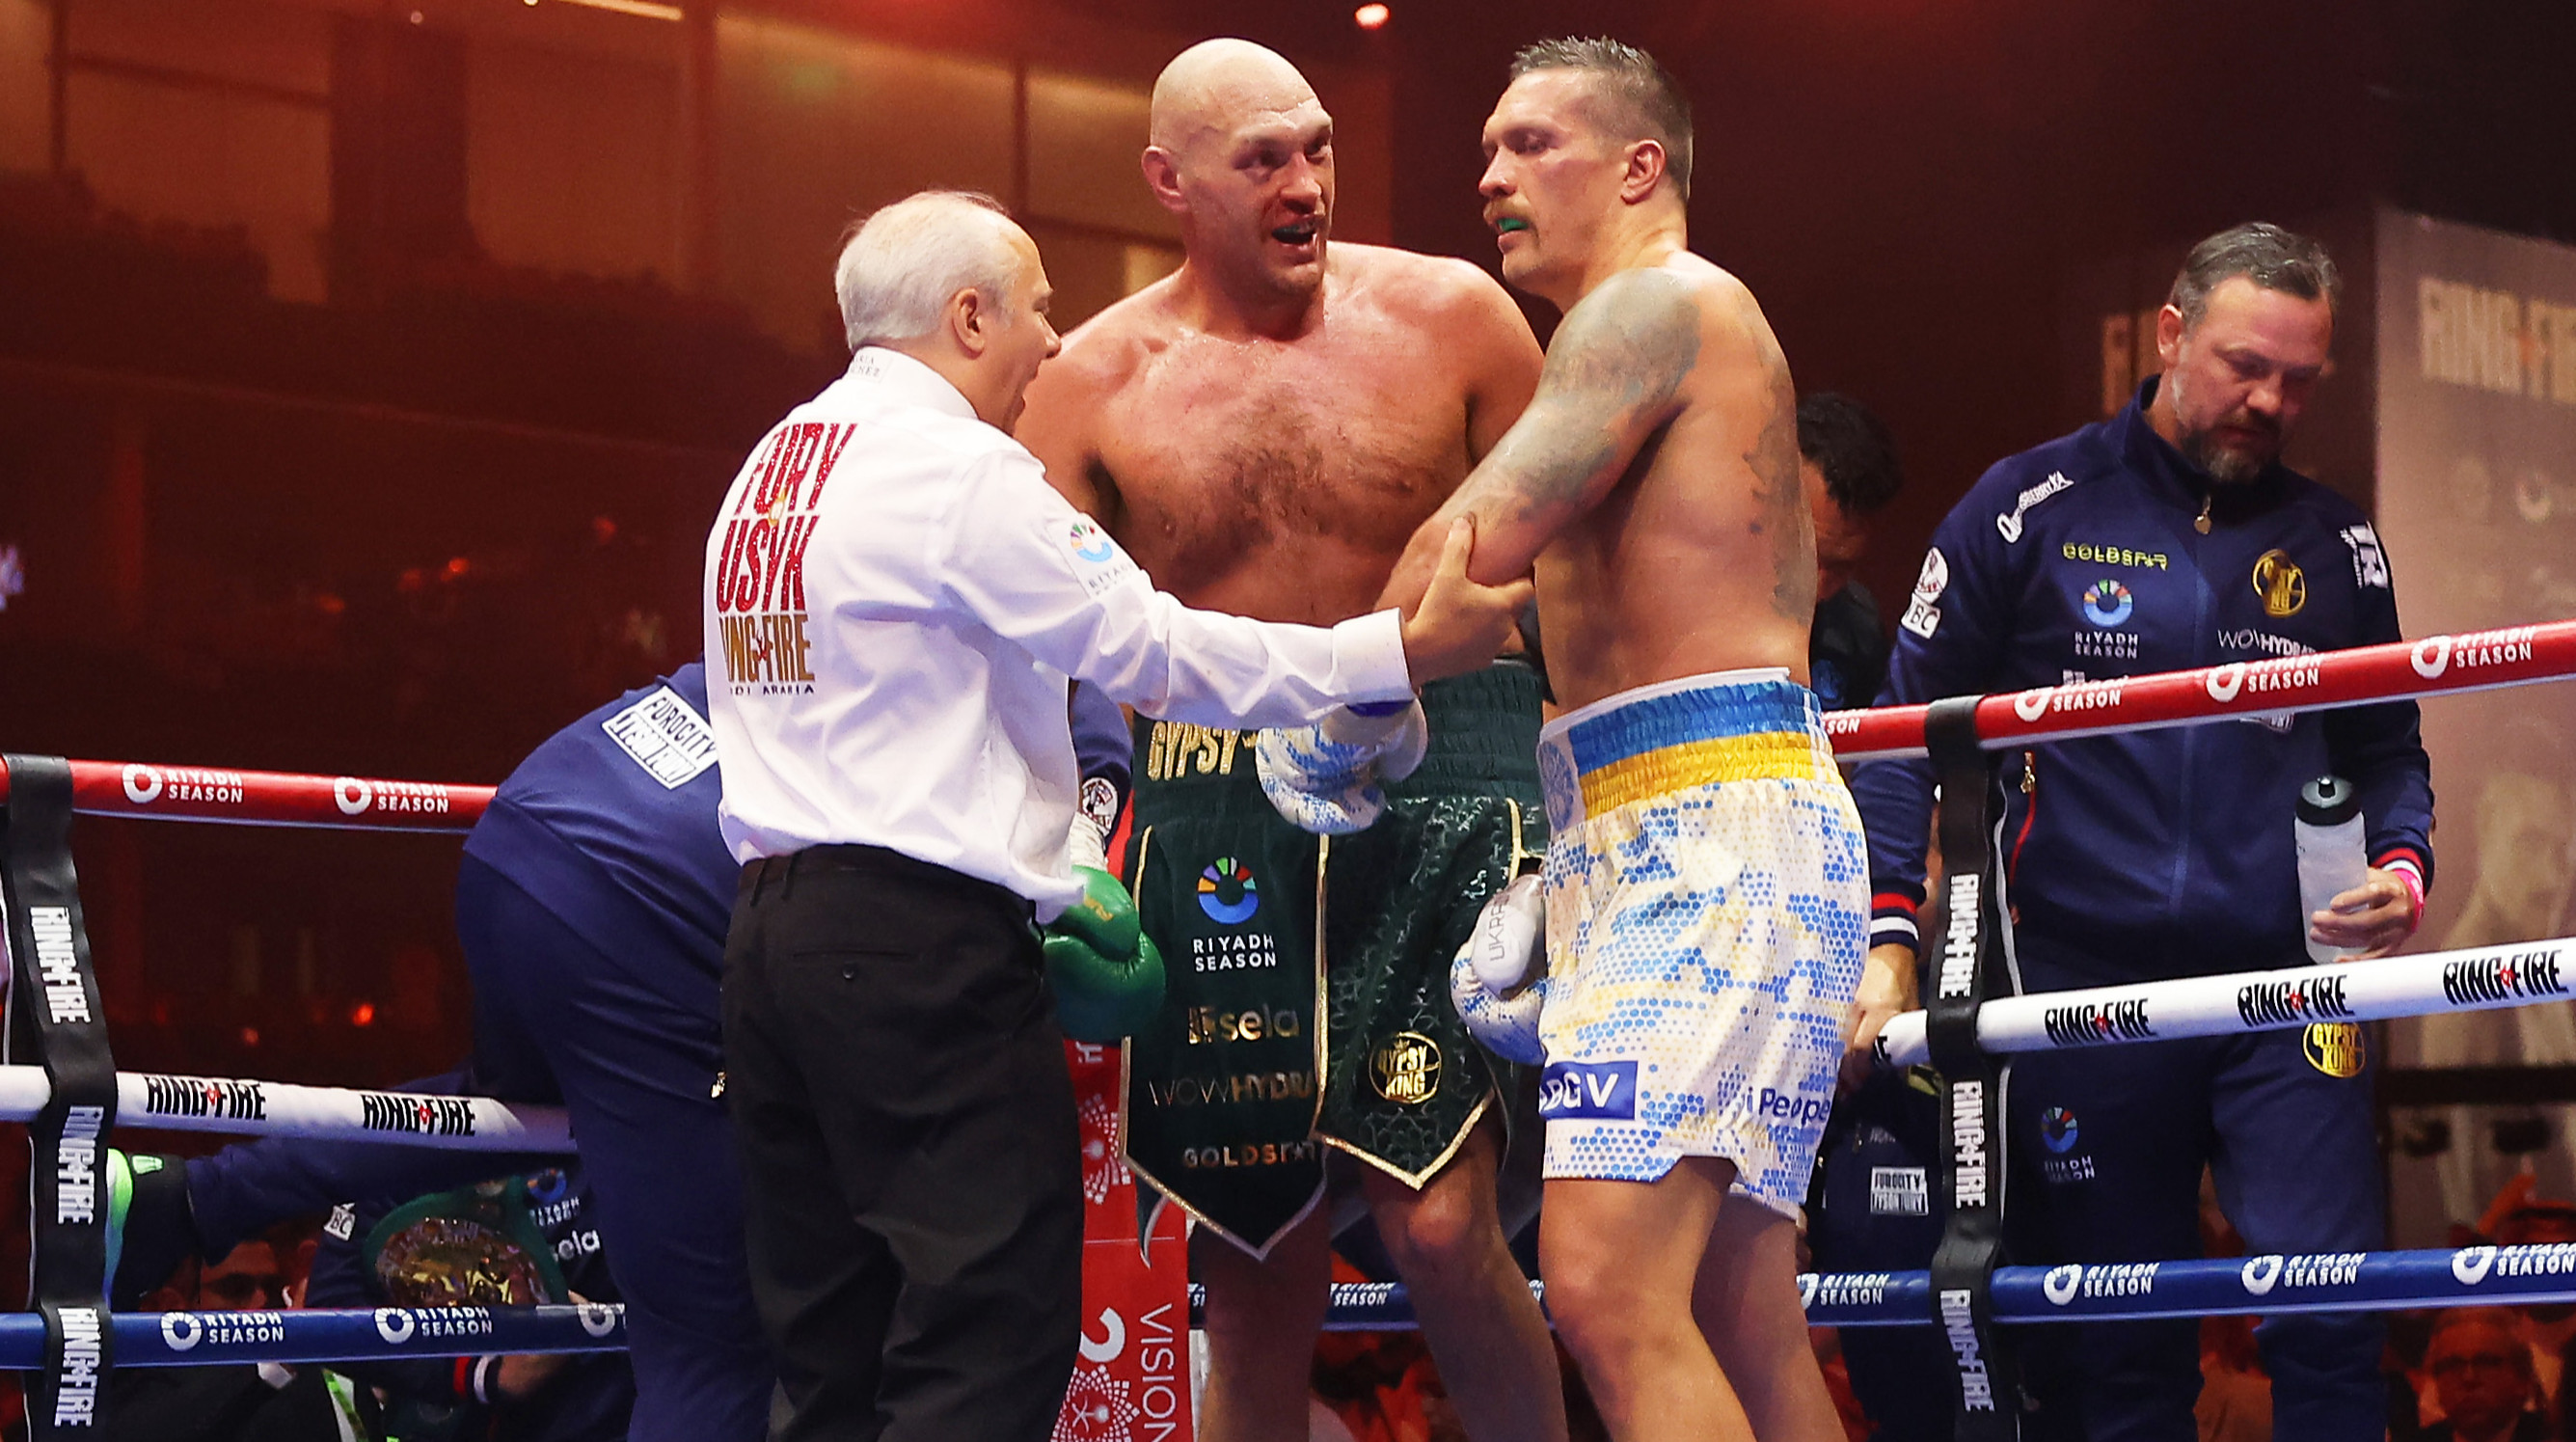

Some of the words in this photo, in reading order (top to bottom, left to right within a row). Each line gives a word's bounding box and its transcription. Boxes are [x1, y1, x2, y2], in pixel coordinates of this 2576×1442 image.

[733, 422, 858, 517] FURY
[716, 515, 820, 613] USYK
[1910, 602, 1939, 631] BC
[719, 615, 759, 683] ING
[761, 614, 815, 682] FIRE
[2074, 631, 2138, 646] RIYADH
[2074, 643, 2137, 660] SEASON
[2455, 641, 2532, 668] SEASON
[2248, 667, 2319, 693] SEASON
[2052, 689, 2121, 712] SEASON
[642, 696, 717, 760] FUROCITY
[1148, 721, 1241, 781] GYPSY
[168, 784, 243, 803] SEASON
[377, 796, 449, 814] SEASON
[1193, 934, 1275, 954] RIYADH
[1195, 951, 1277, 972] SEASON
[1219, 1003, 1301, 1042] sela
[2313, 1022, 2357, 1048] GYPSY
[2322, 1045, 2357, 1074] KING
[1386, 1072, 1425, 1099] KING
[2284, 1265, 2357, 1288] SEASON
[2496, 1254, 2576, 1277] SEASON
[1820, 1288, 1884, 1305] SEASON
[2083, 1276, 2153, 1298] SEASON
[1334, 1292, 1387, 1307] SEASON
[203, 1312, 283, 1326] RIYADH
[415, 1306, 490, 1322] RIYADH
[207, 1325, 285, 1345] SEASON
[421, 1320, 494, 1337] SEASON
